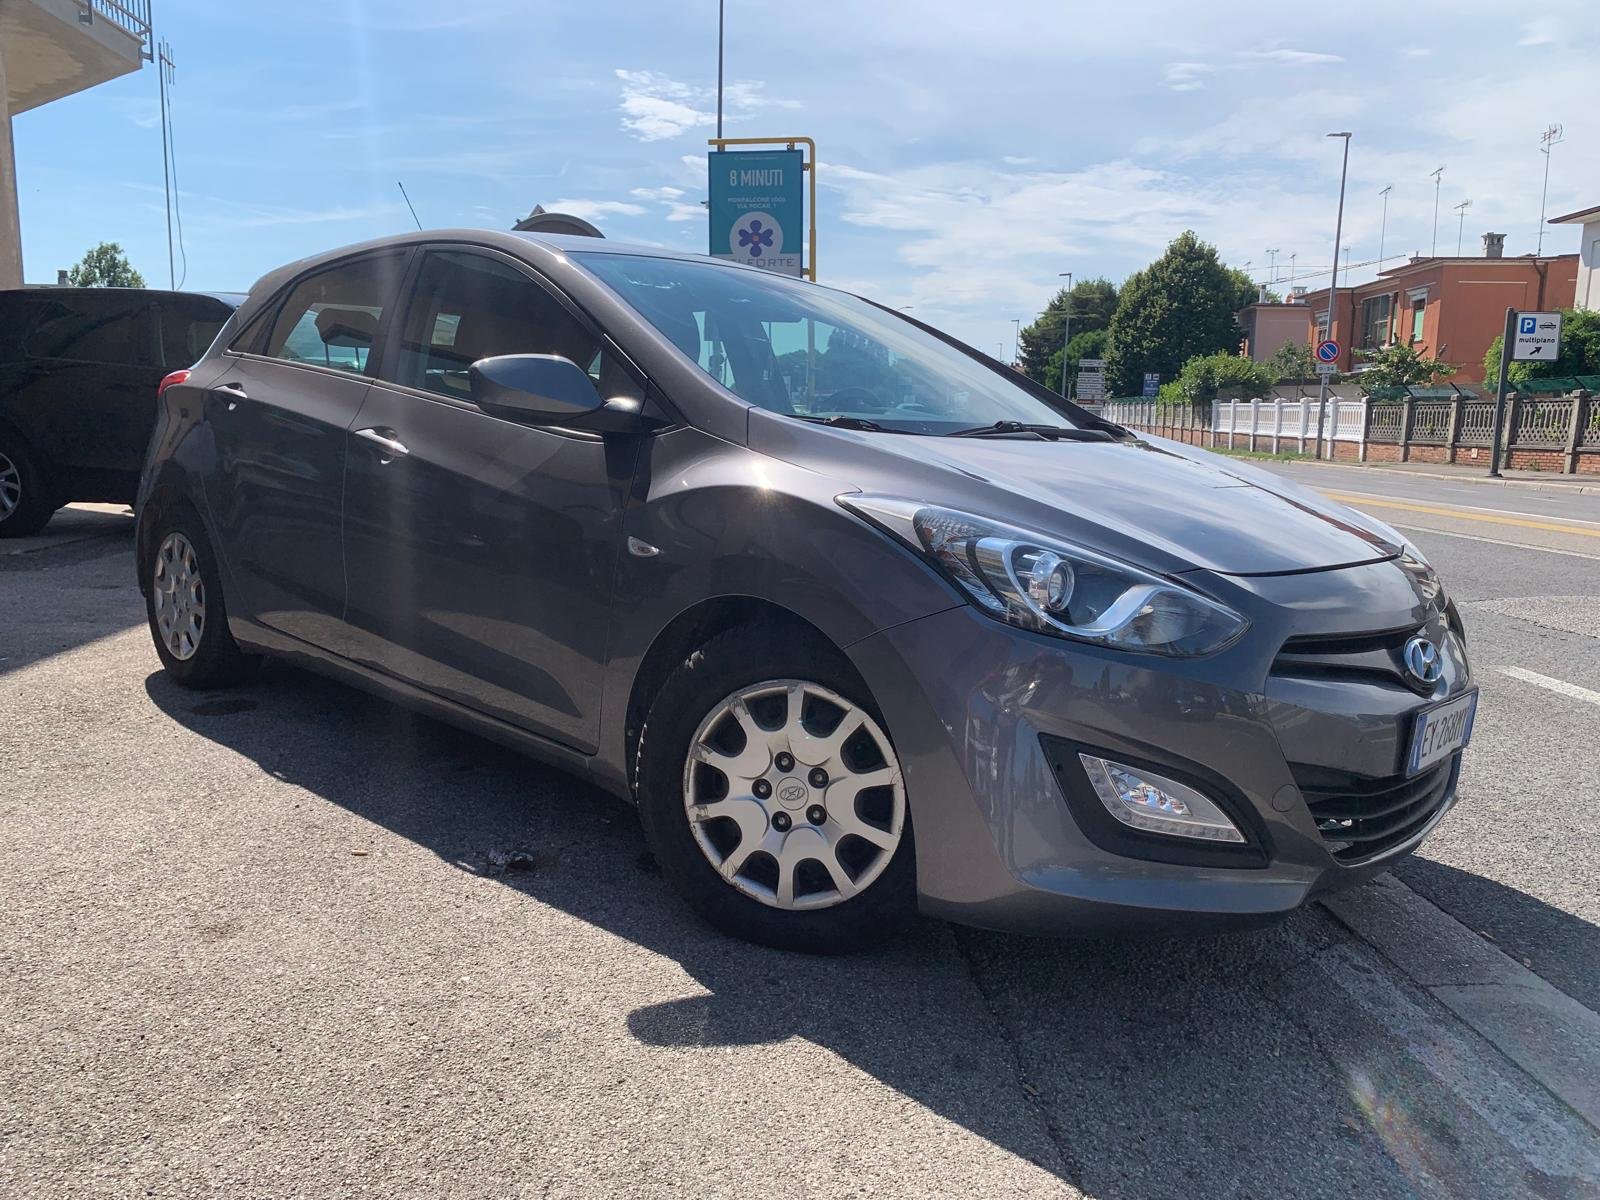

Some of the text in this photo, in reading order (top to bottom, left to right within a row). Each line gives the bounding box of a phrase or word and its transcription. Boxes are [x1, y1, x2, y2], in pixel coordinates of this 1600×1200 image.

[729, 169, 783, 186] 8 MINUTI
[1523, 319, 1534, 332] P
